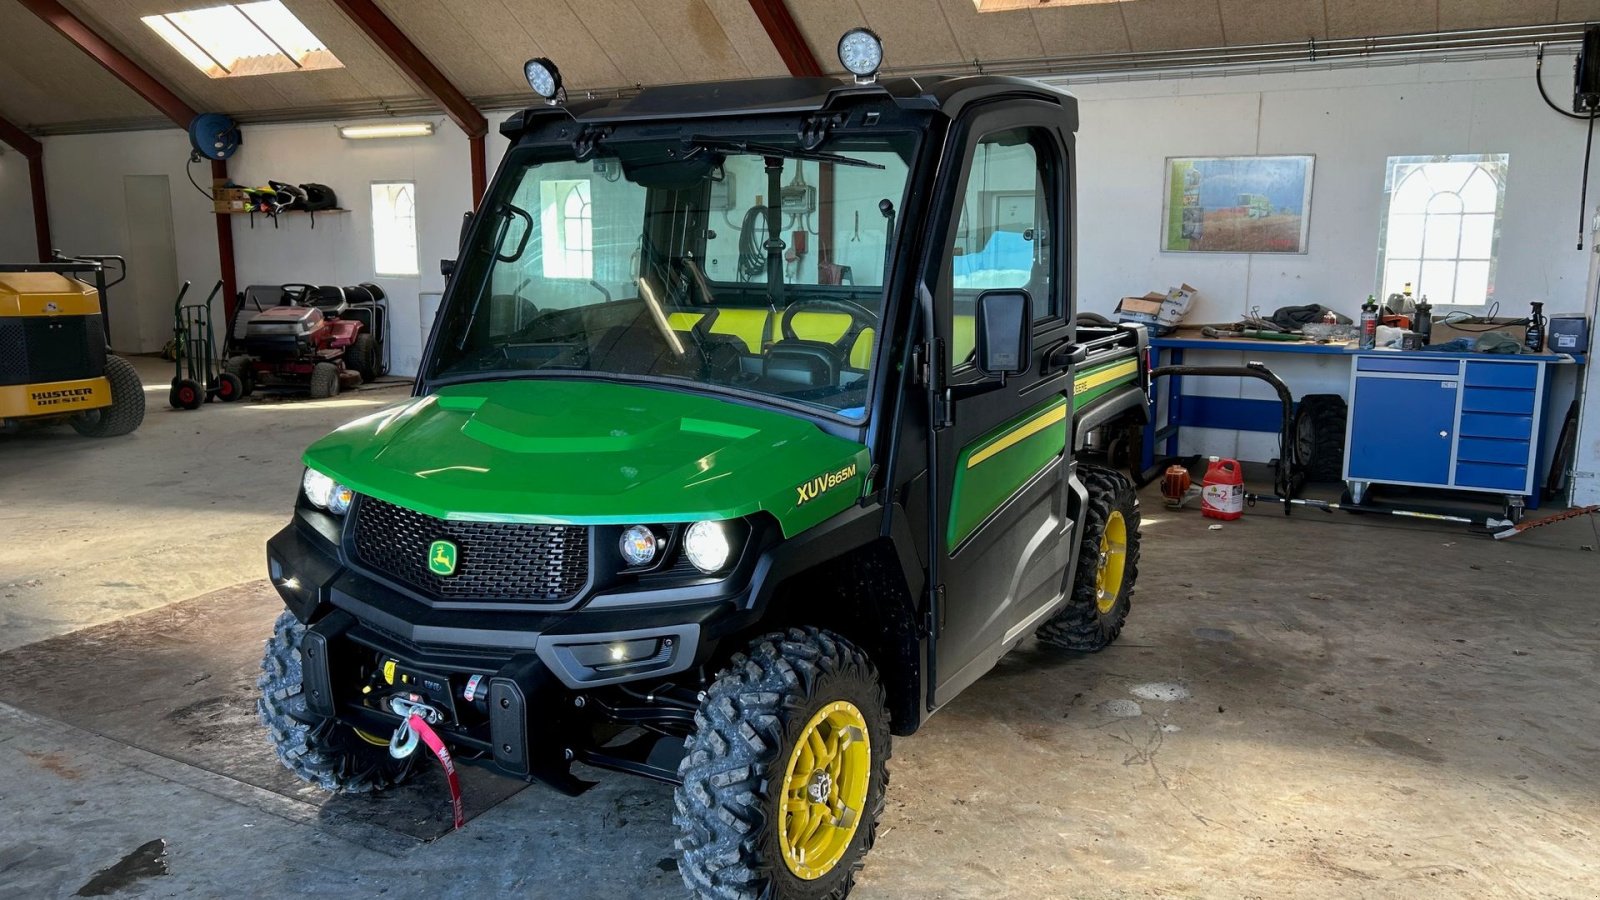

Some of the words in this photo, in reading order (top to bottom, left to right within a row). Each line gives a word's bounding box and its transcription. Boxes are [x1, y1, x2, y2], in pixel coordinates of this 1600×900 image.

[1075, 381, 1087, 393] EERE
[31, 388, 92, 399] HUSTLER
[37, 396, 88, 405] DIESEL
[796, 464, 856, 505] XUV865M
